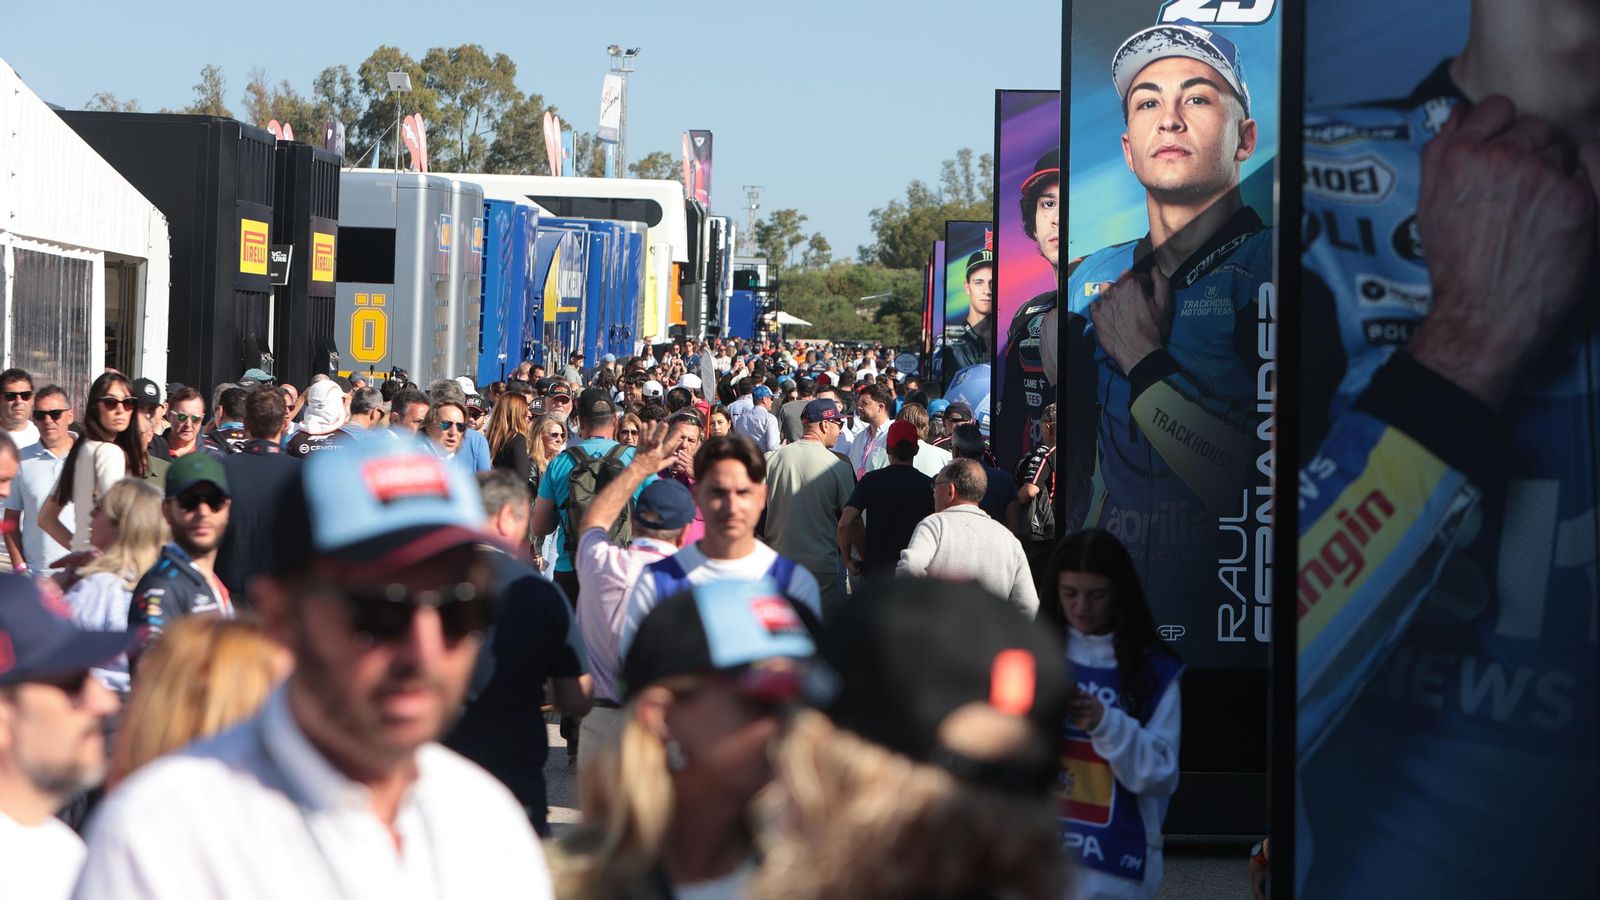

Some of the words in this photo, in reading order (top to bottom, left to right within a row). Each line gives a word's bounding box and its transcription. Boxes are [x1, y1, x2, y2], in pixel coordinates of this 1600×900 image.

[243, 230, 267, 264] PIRELLI
[314, 243, 333, 272] PIRELLI
[1151, 407, 1239, 473] TRACKHOUSE
[1217, 488, 1249, 643] RAUL
[1057, 831, 1105, 862] PA
